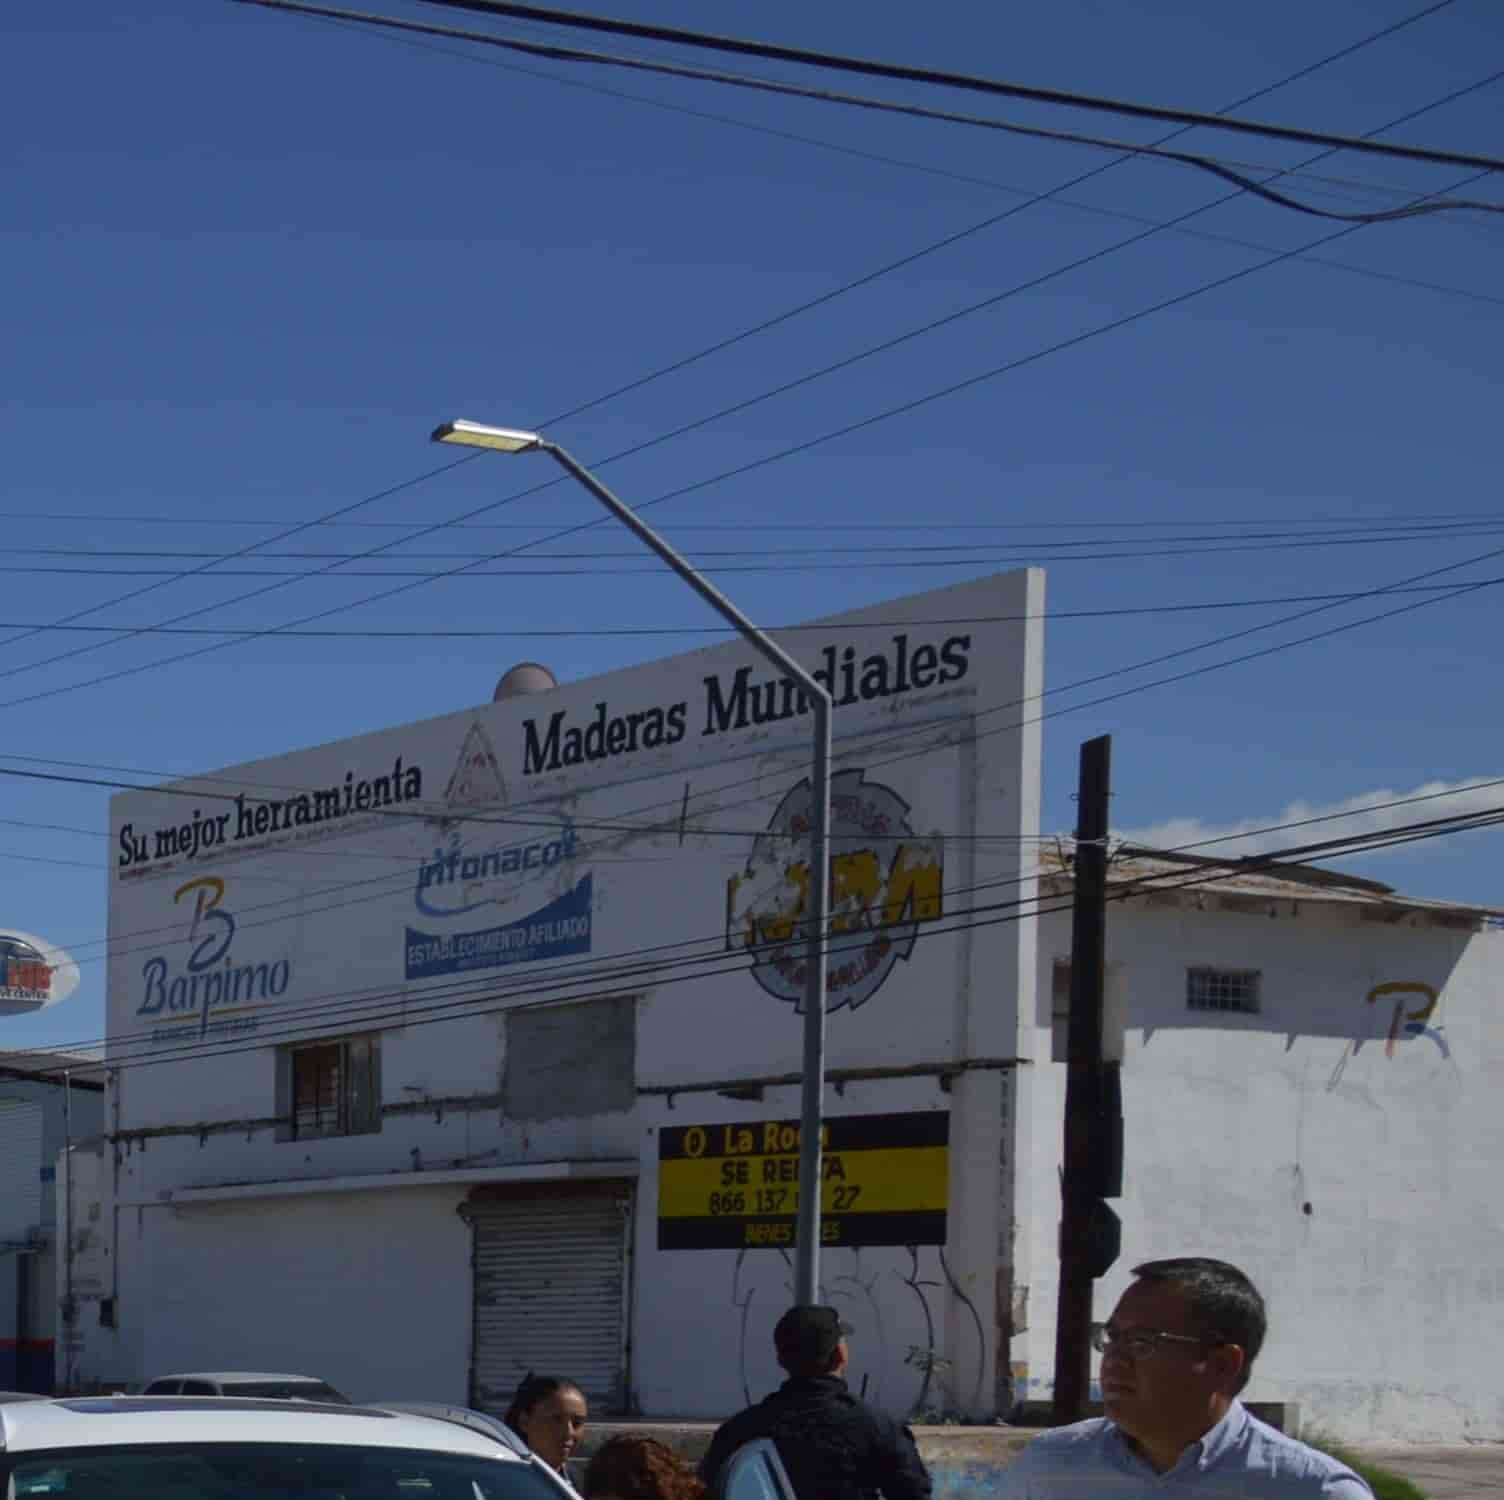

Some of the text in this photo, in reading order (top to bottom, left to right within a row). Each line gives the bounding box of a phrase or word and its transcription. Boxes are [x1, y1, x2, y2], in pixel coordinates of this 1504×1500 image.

[522, 701, 687, 776] Maderas
[119, 755, 422, 866] Su mejor herramienta
[528, 914, 589, 945] AFILIADO
[136, 956, 290, 1042] Barpimo
[723, 1125, 754, 1154] La
[763, 1121, 832, 1153] Roa
[721, 1159, 750, 1186] SE
[709, 1184, 862, 1216] 866 137 27
